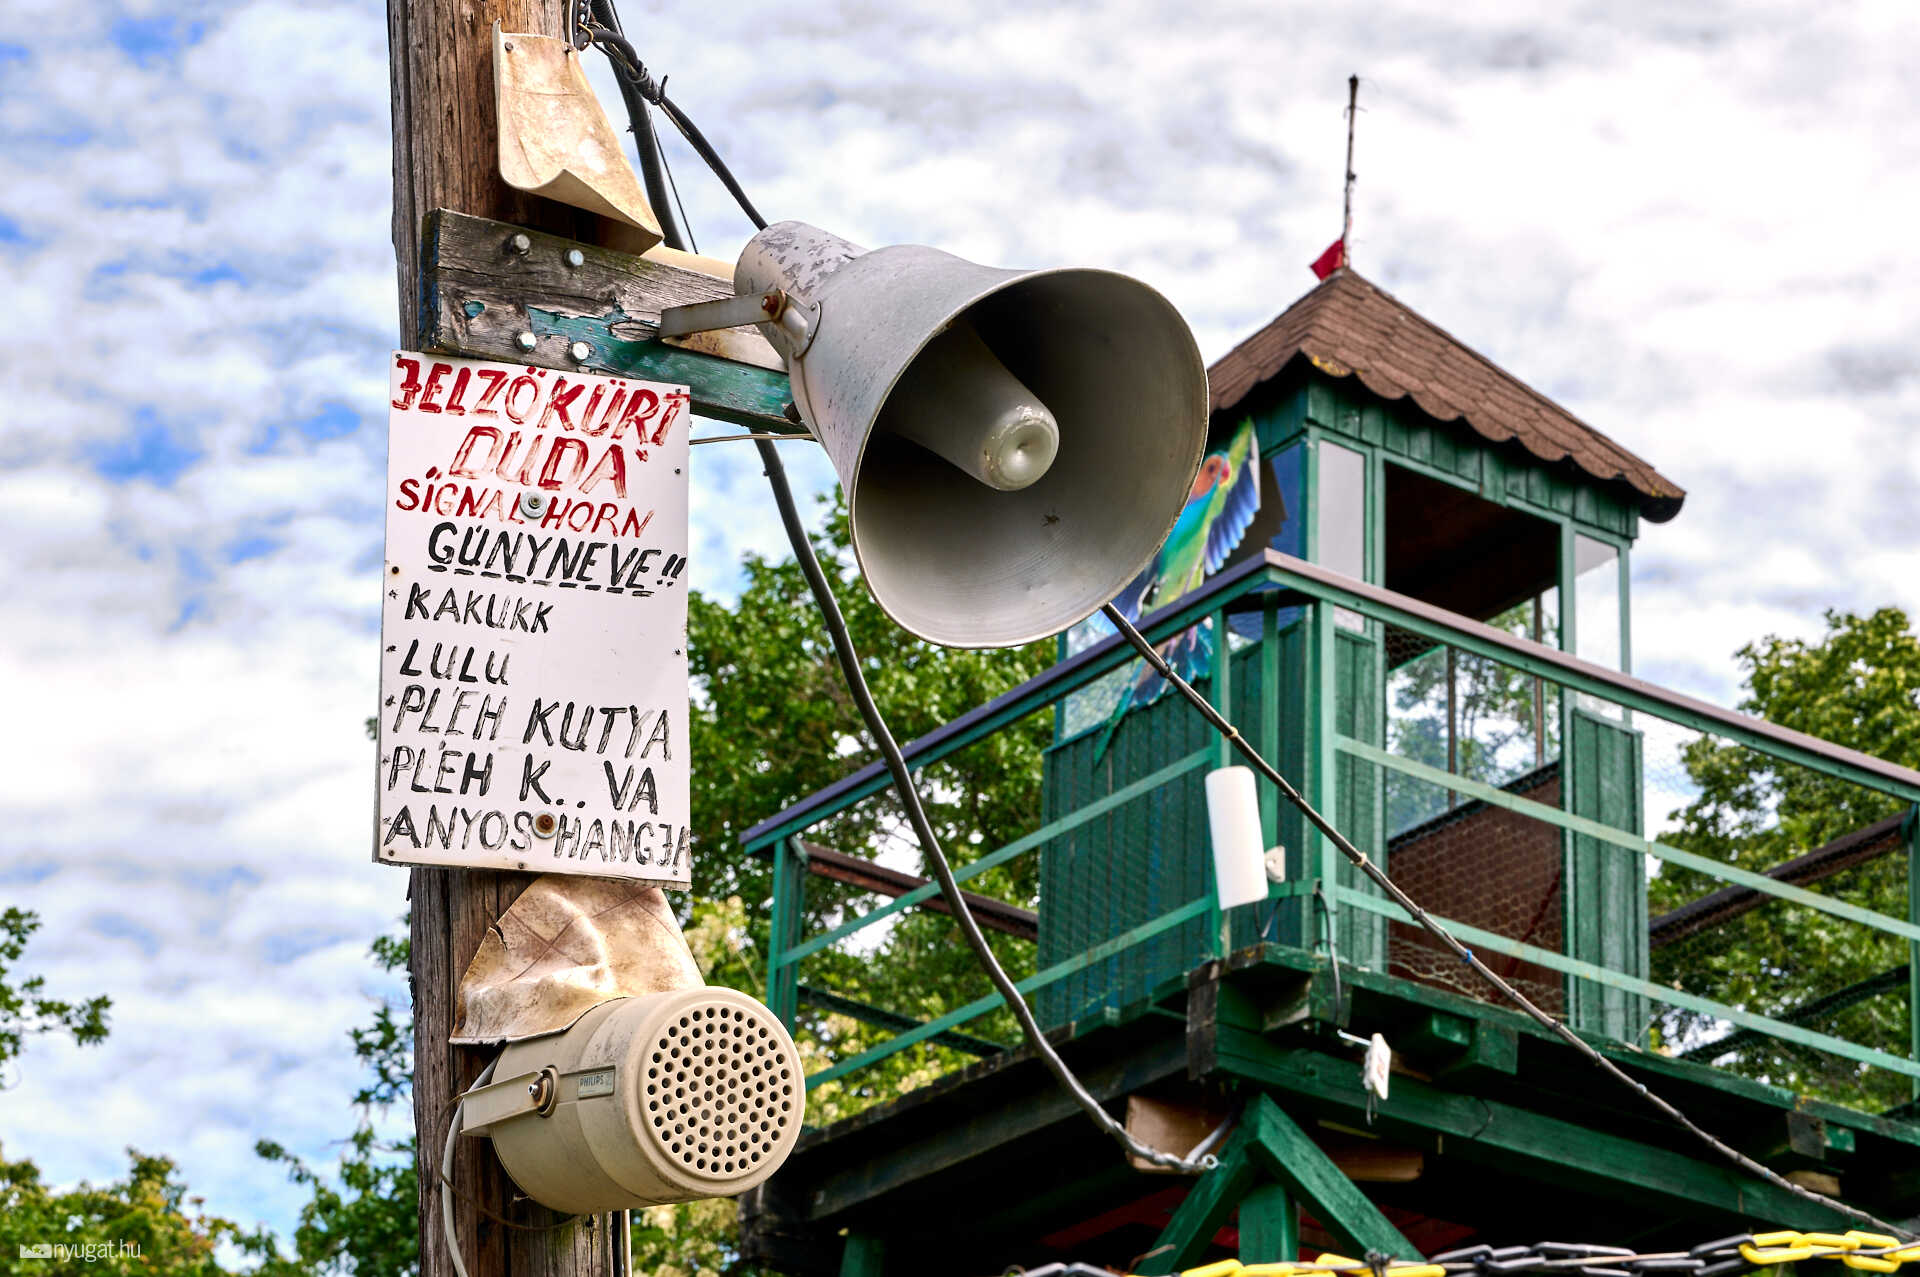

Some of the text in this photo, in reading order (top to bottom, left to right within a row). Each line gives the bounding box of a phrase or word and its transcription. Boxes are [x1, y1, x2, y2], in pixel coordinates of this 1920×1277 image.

[540, 496, 655, 537] HORN
[405, 582, 554, 633] KAKUKK
[400, 639, 510, 685] LULU
[393, 684, 672, 762] PLÉH KUTYA
[388, 740, 493, 796] PLÉH
[604, 760, 659, 815] VA
[580, 1074, 605, 1087] PHILIPS
